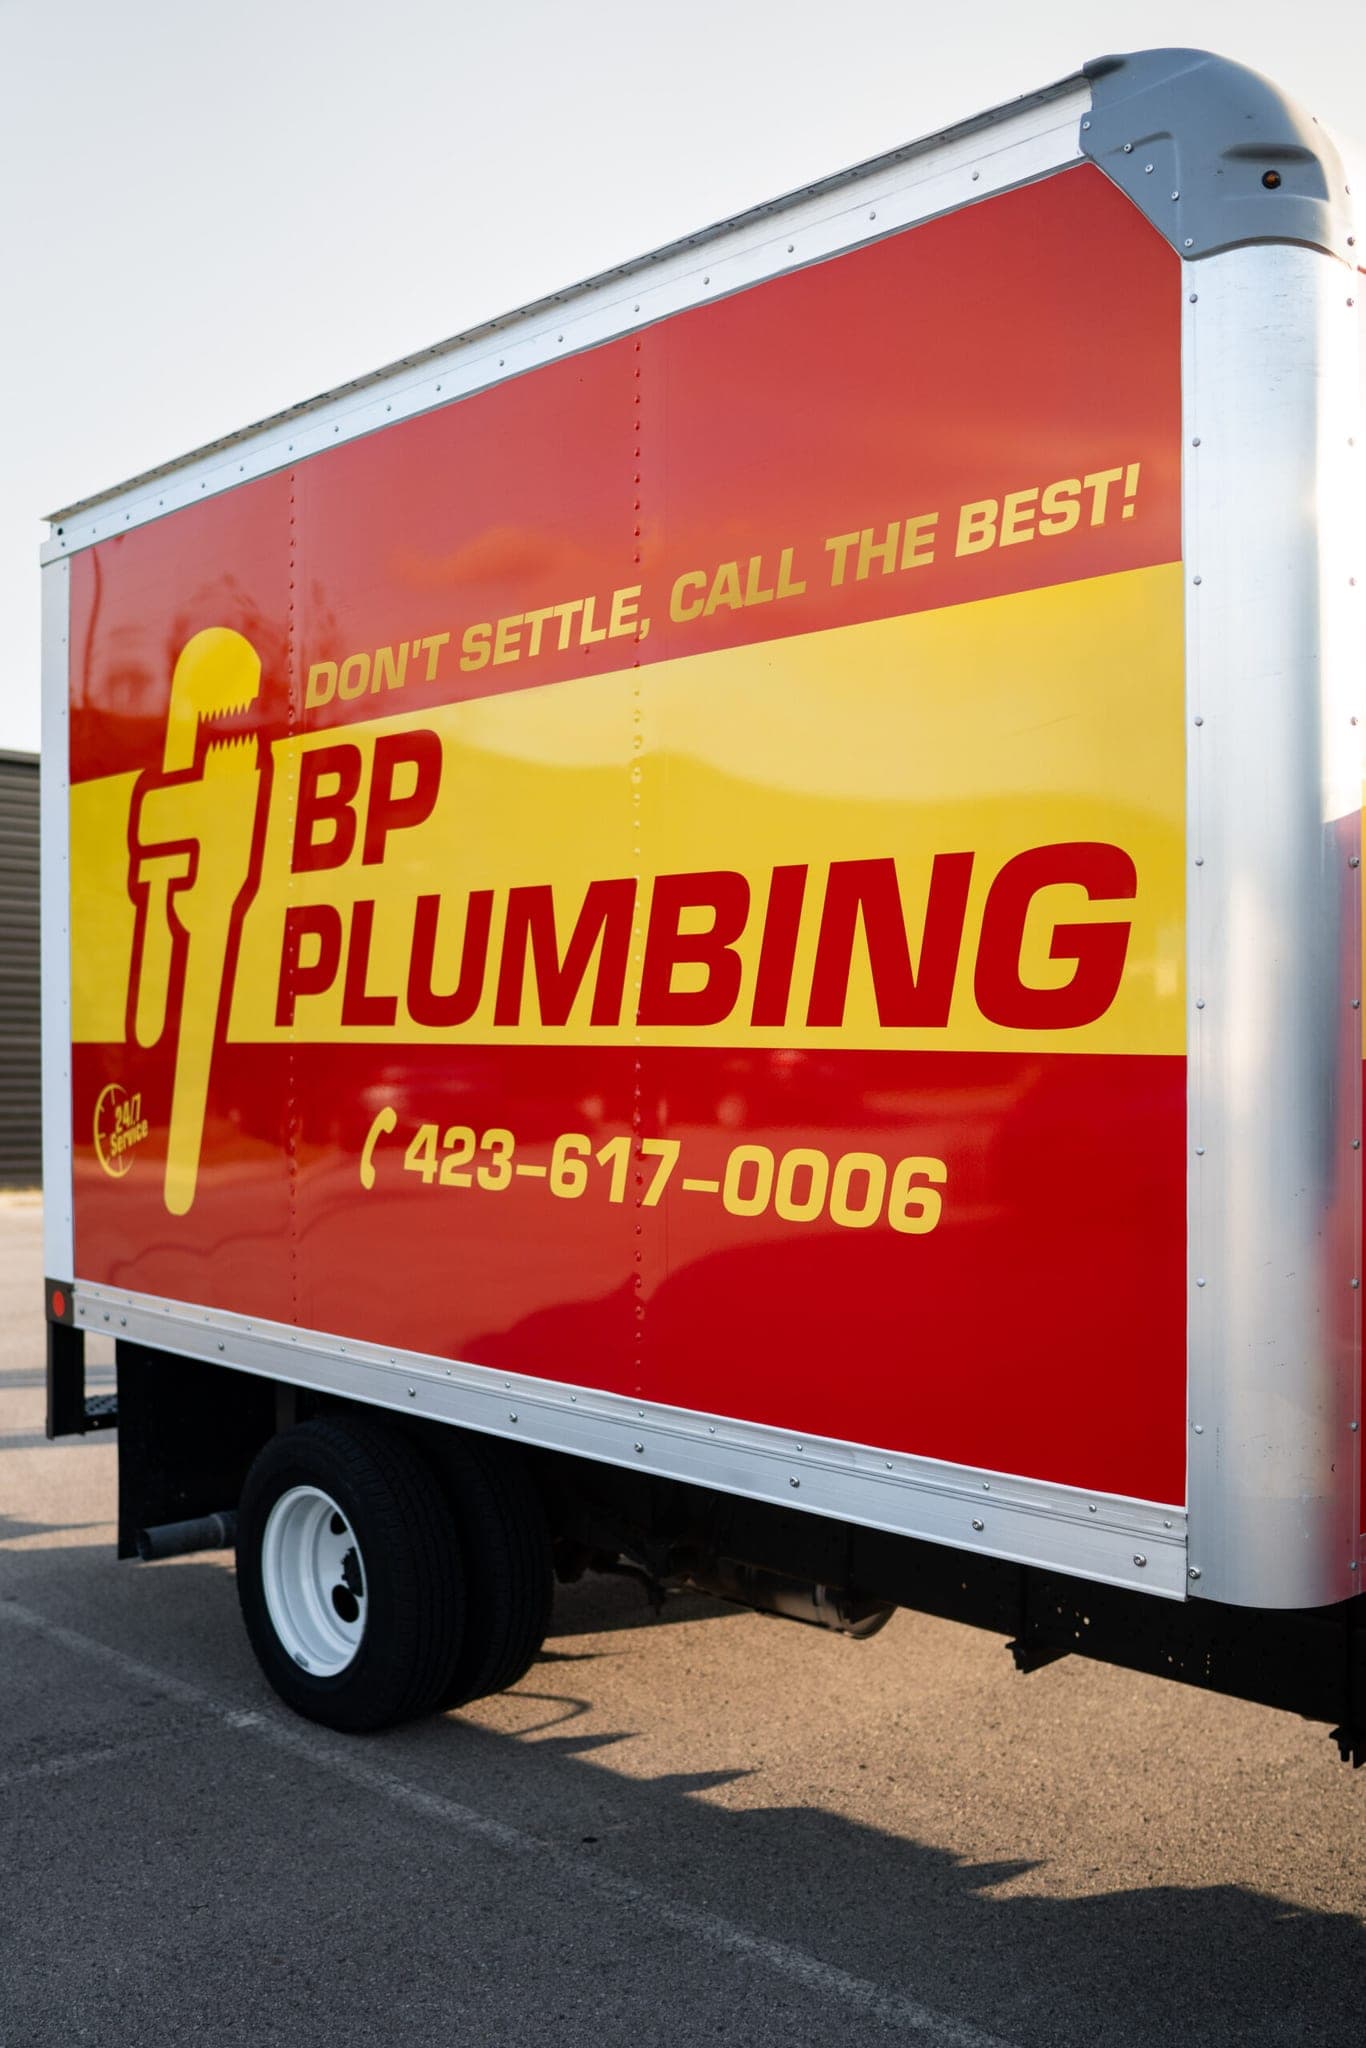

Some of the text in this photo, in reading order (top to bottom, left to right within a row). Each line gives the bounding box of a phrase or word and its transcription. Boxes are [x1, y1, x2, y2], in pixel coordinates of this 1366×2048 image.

[304, 462, 1141, 709] DON'T SETTLE, CALL THE BEST!
[291, 729, 443, 874] BP
[274, 841, 1138, 1030] PLUMBING
[403, 1124, 948, 1235] 423-617-0006
